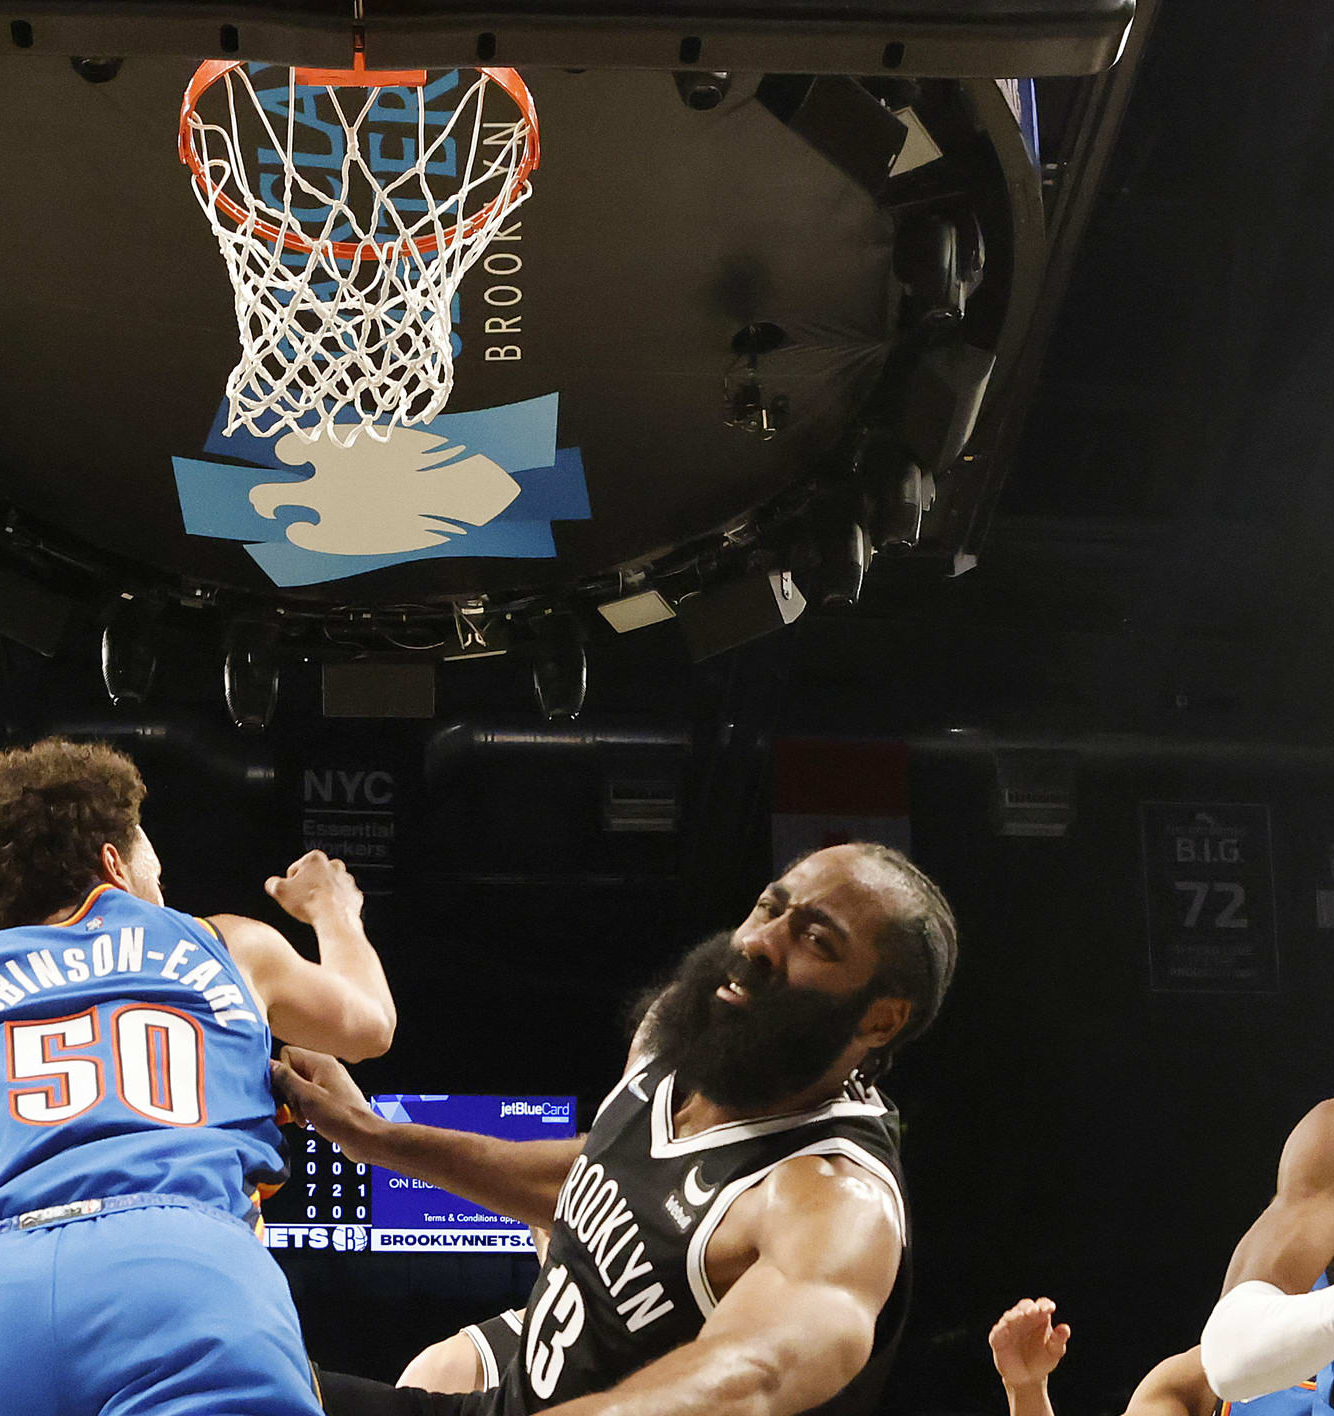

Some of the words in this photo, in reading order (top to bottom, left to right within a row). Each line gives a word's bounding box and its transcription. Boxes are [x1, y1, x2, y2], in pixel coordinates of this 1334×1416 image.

[304, 769, 395, 804] NYC
[302, 819, 395, 838] Essential
[1174, 880, 1249, 928] 72
[3, 1003, 208, 1127] 50
[500, 1102, 570, 1118] jetBlueCard
[306, 1140, 316, 1153] 2
[306, 1162, 316, 1175] 0
[332, 1162, 342, 1175] 0
[356, 1163, 366, 1176] 0
[306, 1184, 316, 1197] 7
[332, 1184, 342, 1197] 2
[358, 1184, 365, 1197] 1
[389, 1178, 409, 1189] ON
[306, 1206, 316, 1219] 0
[332, 1206, 342, 1219] 0
[356, 1206, 366, 1219] 0
[424, 1214, 446, 1222] Terms
[448, 1214, 454, 1222] &
[457, 1213, 498, 1223] Conditions
[526, 1264, 585, 1399] 13
